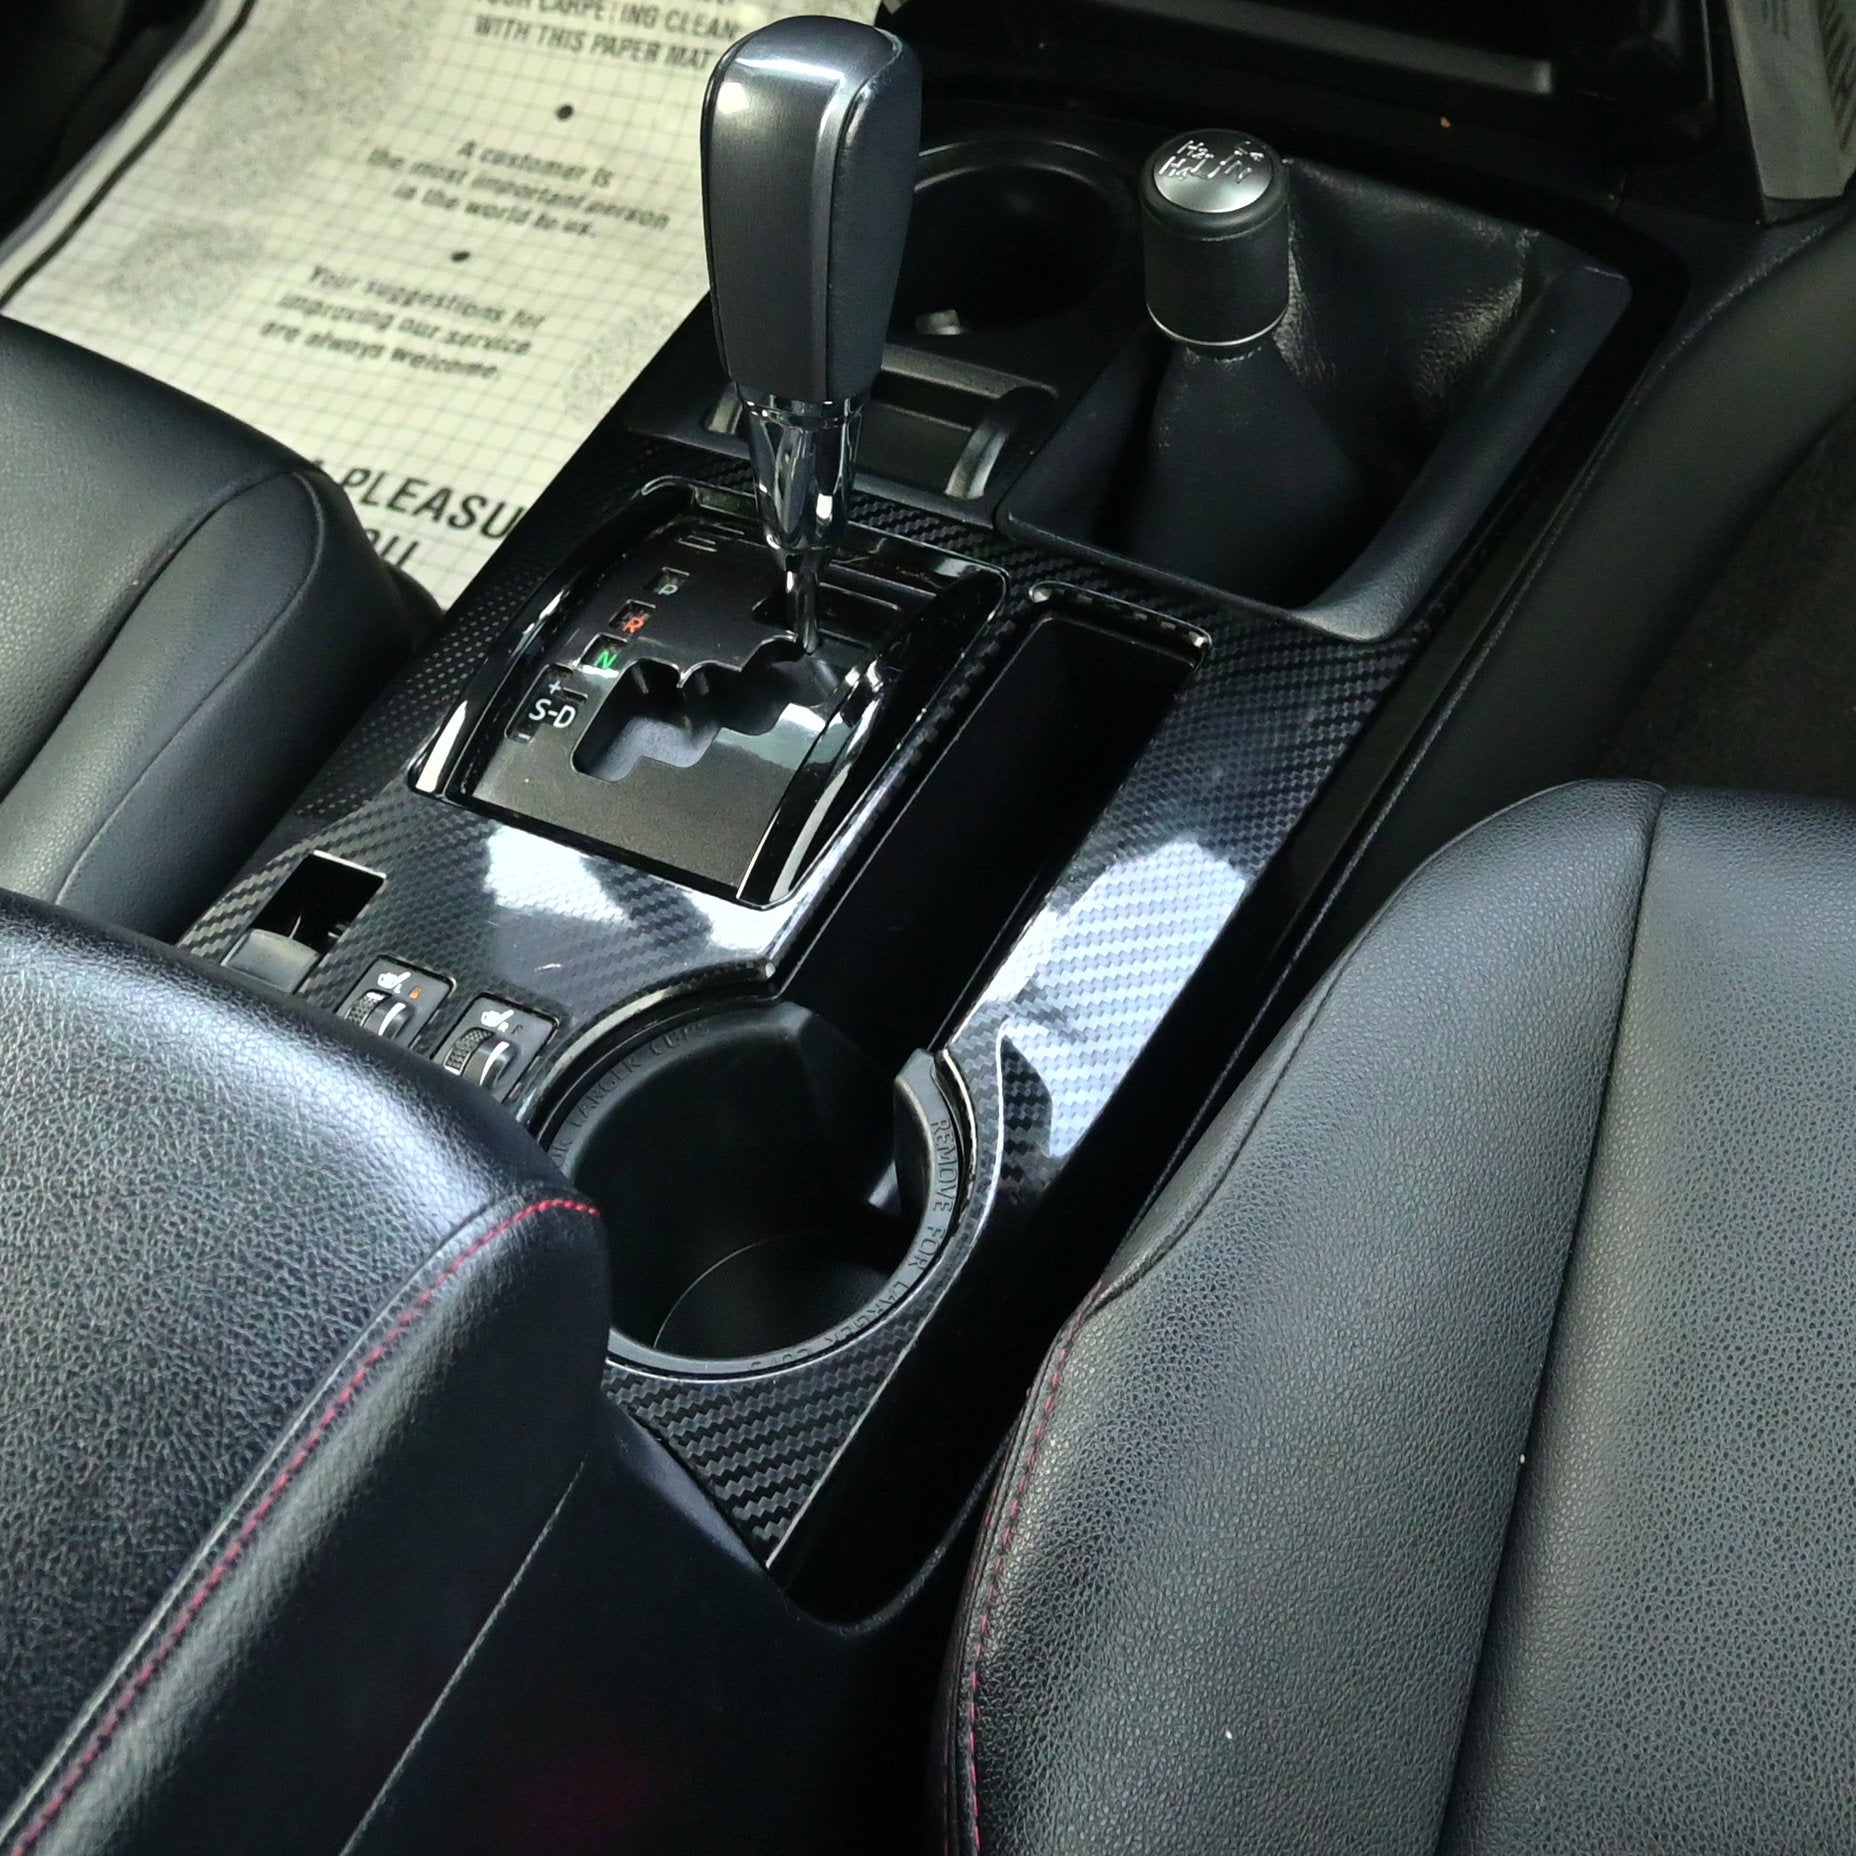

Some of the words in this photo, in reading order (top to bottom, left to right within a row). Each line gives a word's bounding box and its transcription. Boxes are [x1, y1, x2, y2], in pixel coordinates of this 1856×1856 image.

[664, 8, 742, 40] CLEAN
[474, 14, 532, 41] WITH
[537, 24, 587, 54] THIS
[590, 32, 663, 63] PAPER
[665, 44, 714, 71] MAT
[658, 583, 679, 596] P
[621, 616, 646, 634] R
[593, 649, 620, 671] N
[528, 698, 577, 729] S-D
[930, 1119, 960, 1214] REMOVE
[907, 1225, 947, 1272] FOR
